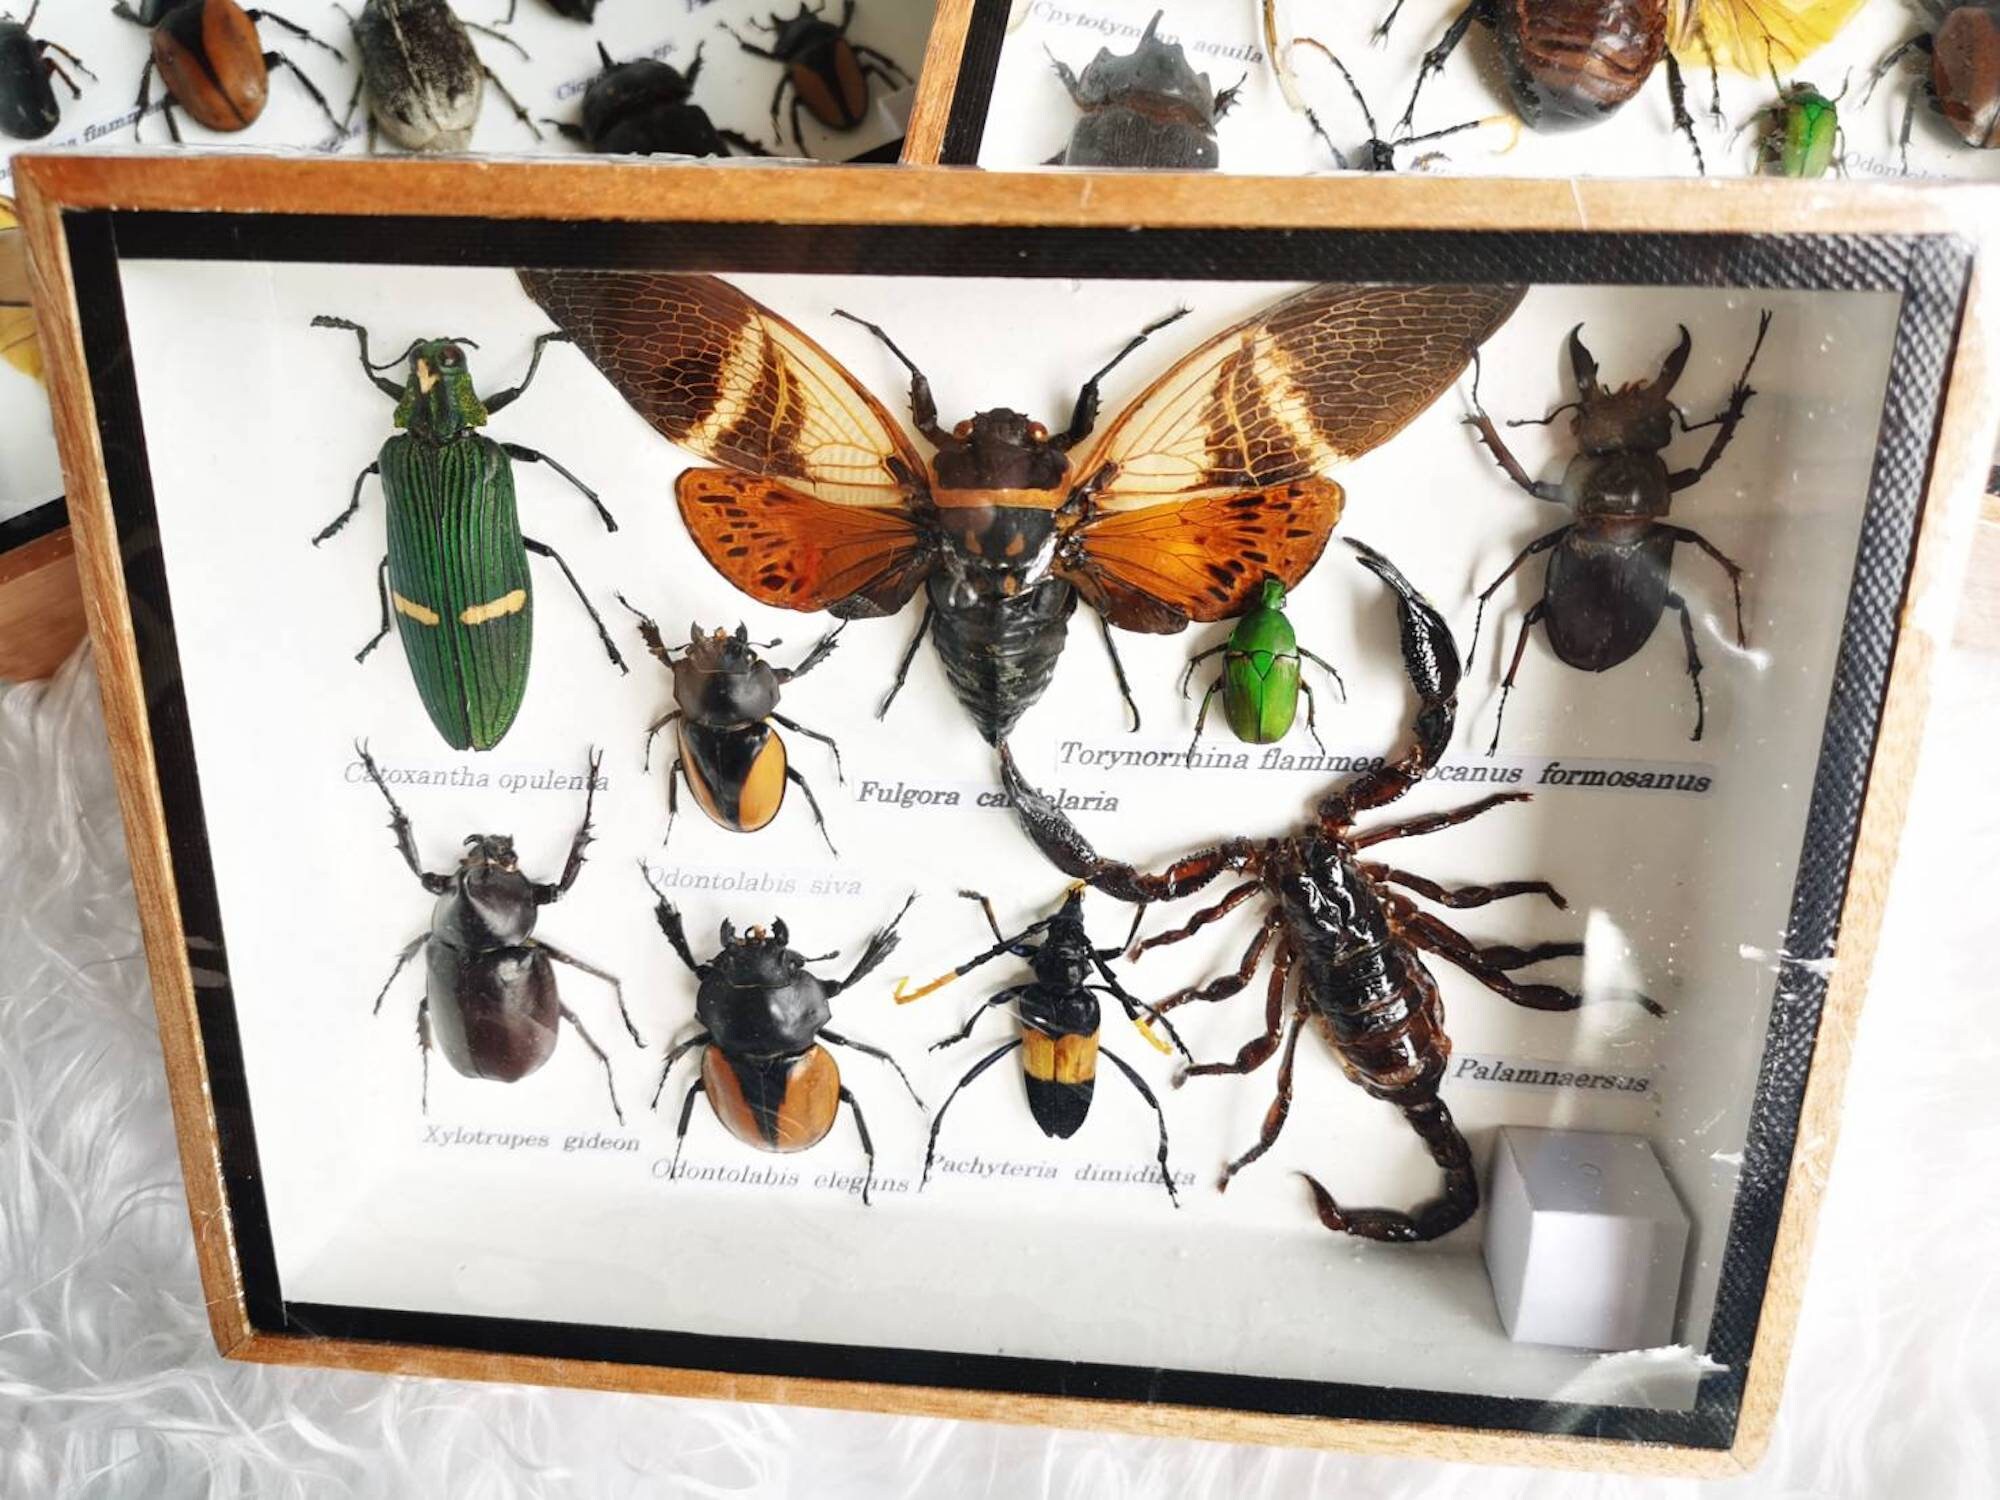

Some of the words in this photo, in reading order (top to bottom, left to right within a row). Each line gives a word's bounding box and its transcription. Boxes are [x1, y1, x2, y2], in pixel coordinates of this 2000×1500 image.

[1060, 741, 1248, 770] Torynorrhina
[1258, 747, 1385, 772] flammea
[499, 770, 609, 793] opulena
[1421, 764, 1524, 783] ocanus
[1536, 762, 1713, 793] formosanus
[856, 781, 961, 808] Fulgora
[976, 786, 1120, 812] caelaria
[810, 873, 862, 895] siva
[422, 1125, 551, 1149] Xylotrupes
[563, 1132, 640, 1152] gideon
[652, 1157, 800, 1186] Odontolabis
